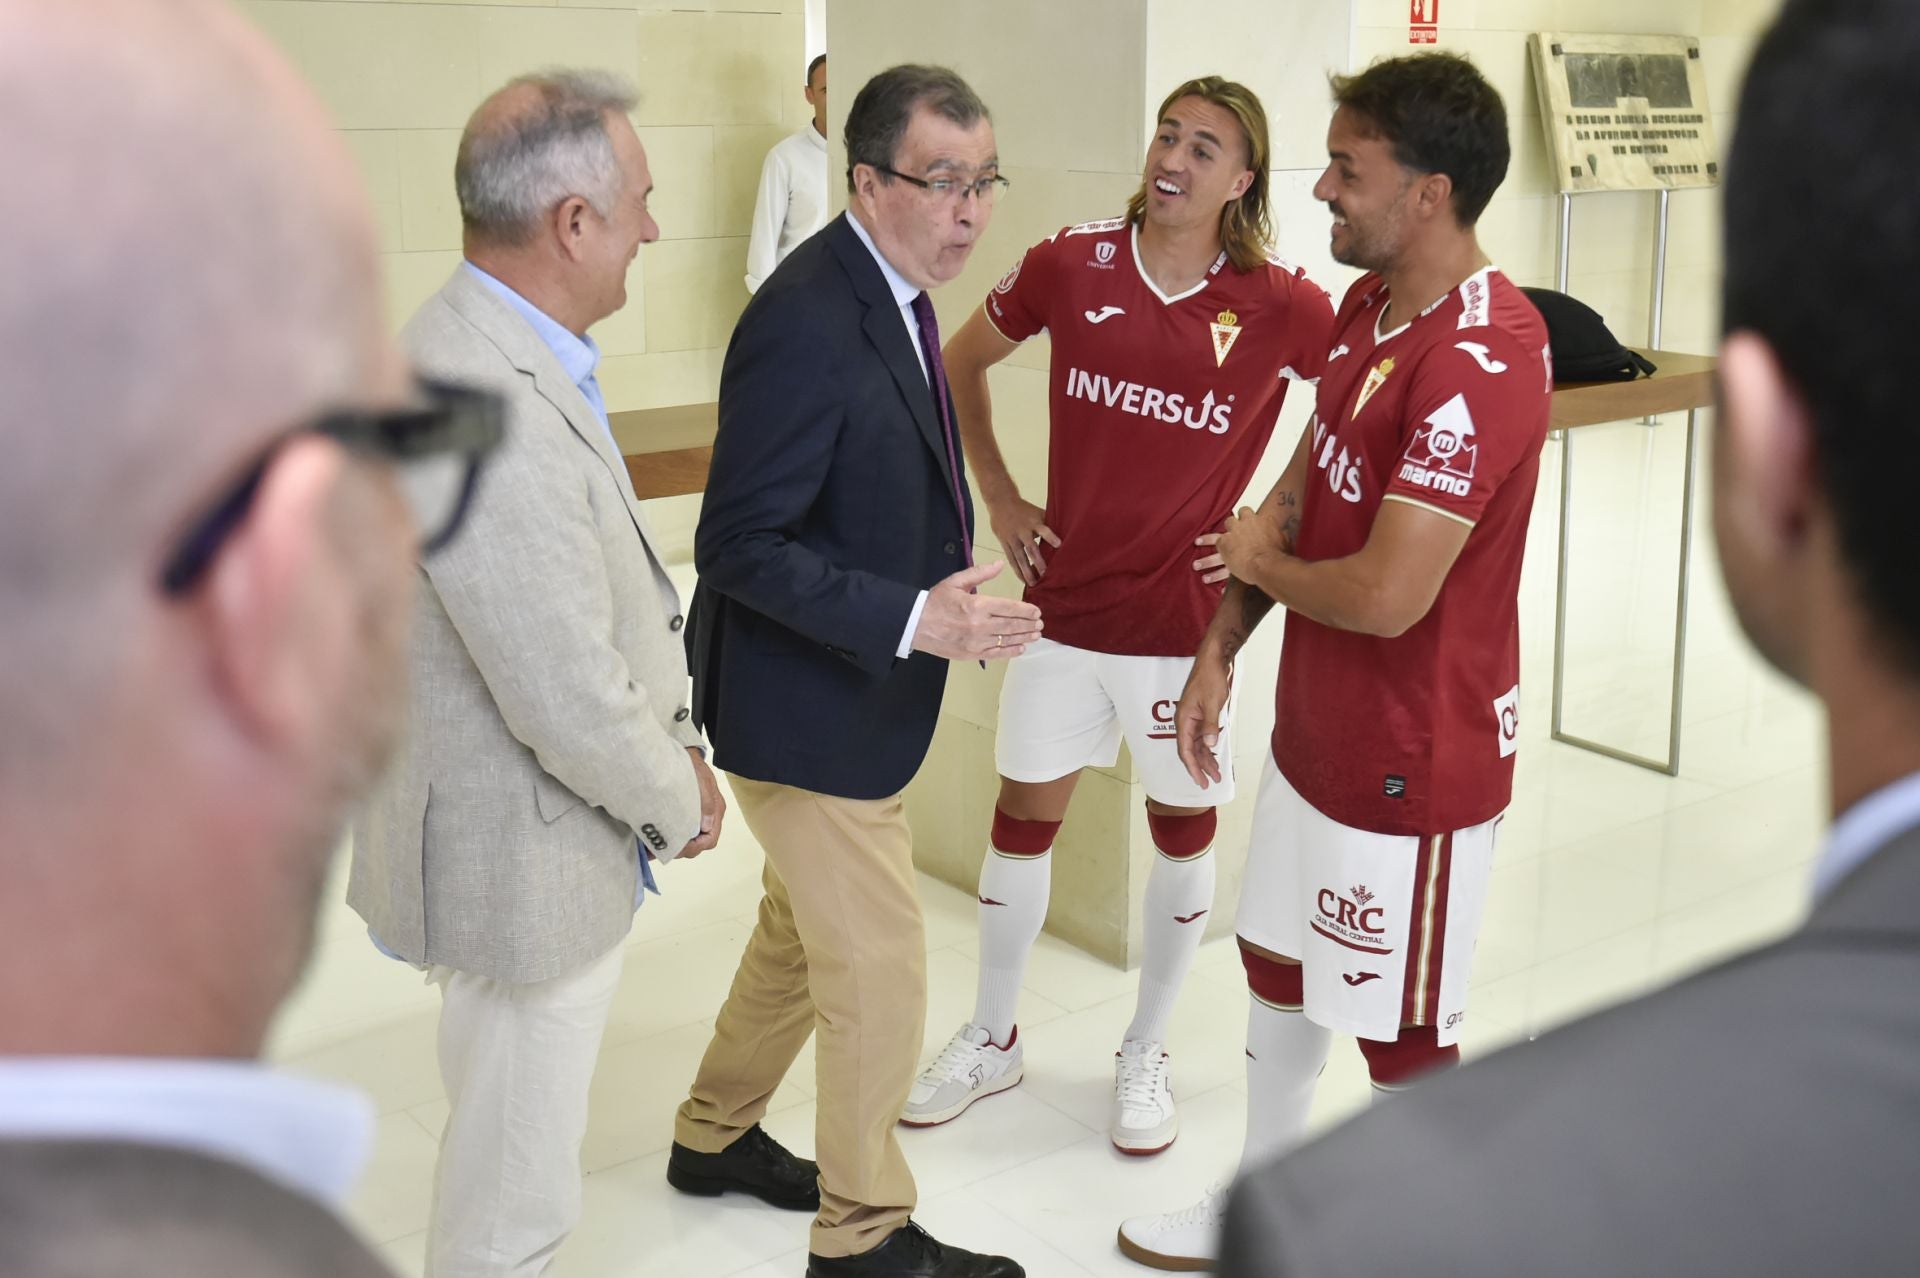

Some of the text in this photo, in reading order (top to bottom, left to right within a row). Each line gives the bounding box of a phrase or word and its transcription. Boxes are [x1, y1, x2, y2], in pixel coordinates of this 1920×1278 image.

[1066, 367, 1233, 435] INVERSUS
[1398, 463, 1472, 497] marmo
[1317, 888, 1385, 934] CRC
[1349, 932, 1384, 945] CENTRAL
